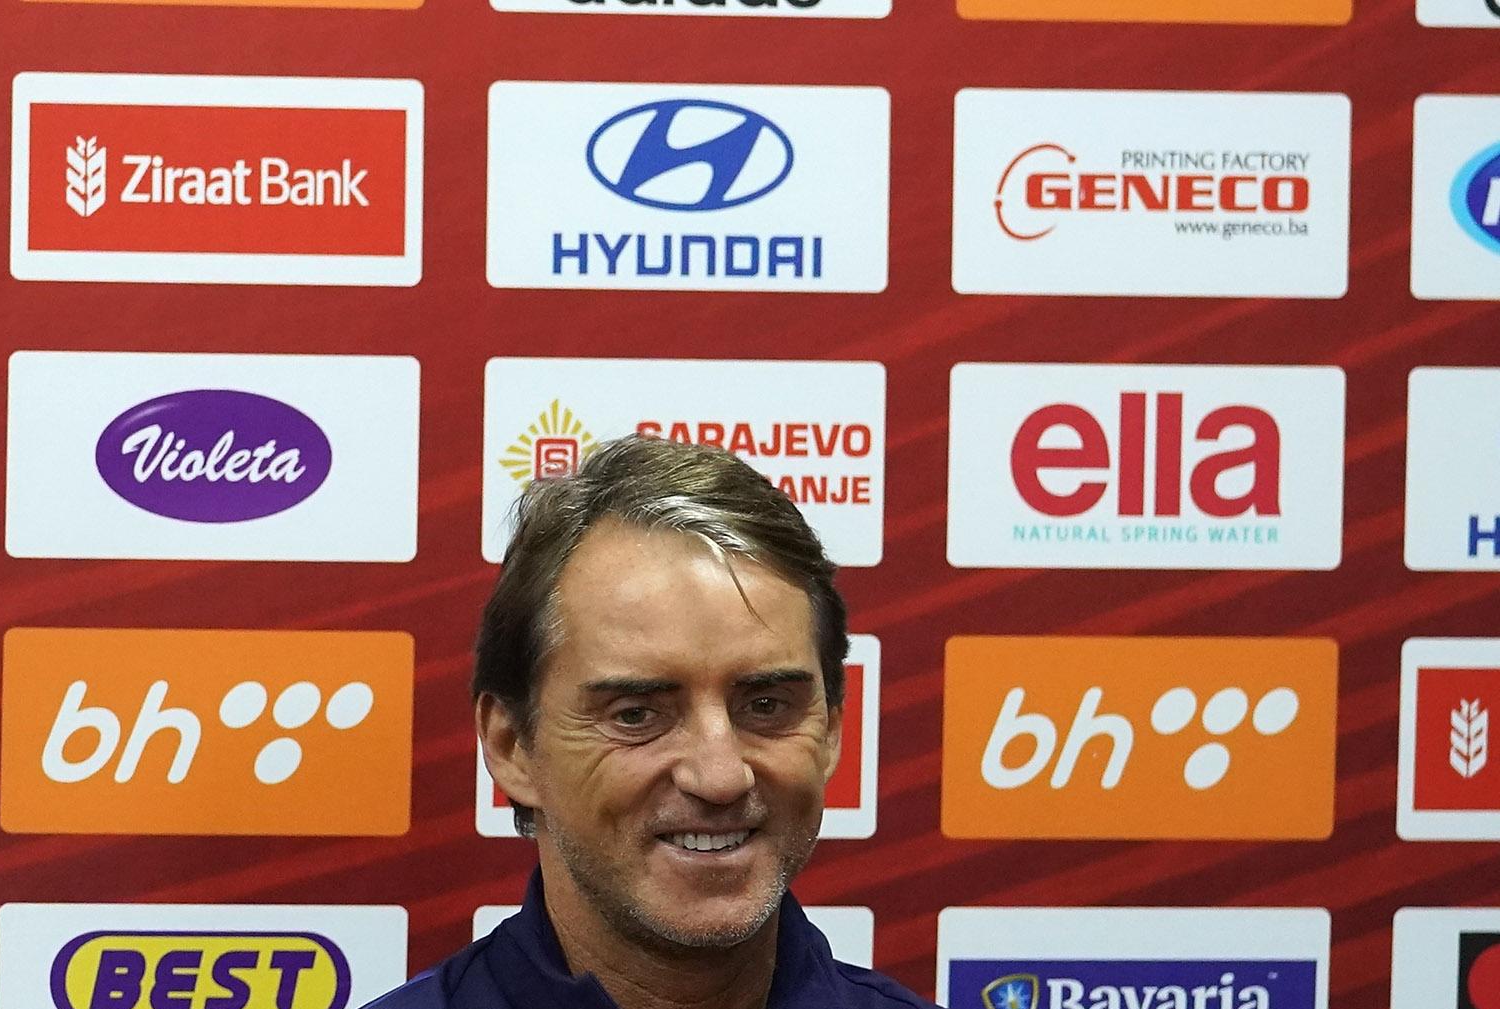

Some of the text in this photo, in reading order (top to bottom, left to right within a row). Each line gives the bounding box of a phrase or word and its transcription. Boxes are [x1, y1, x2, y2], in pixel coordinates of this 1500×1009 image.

[121, 155, 369, 206] Ziraat Bank
[1122, 151, 1309, 171] PRINTING FACTORY
[1025, 172, 1309, 213] GENECO
[1175, 218, 1308, 240] www.geneco.ba
[553, 233, 822, 278] HYUNDAI
[122, 424, 305, 483] Violeta
[1010, 392, 1282, 519] ella
[1013, 524, 1279, 544] NATURAL SPRING WATER
[42, 680, 201, 784] bh
[981, 687, 1134, 789] bh
